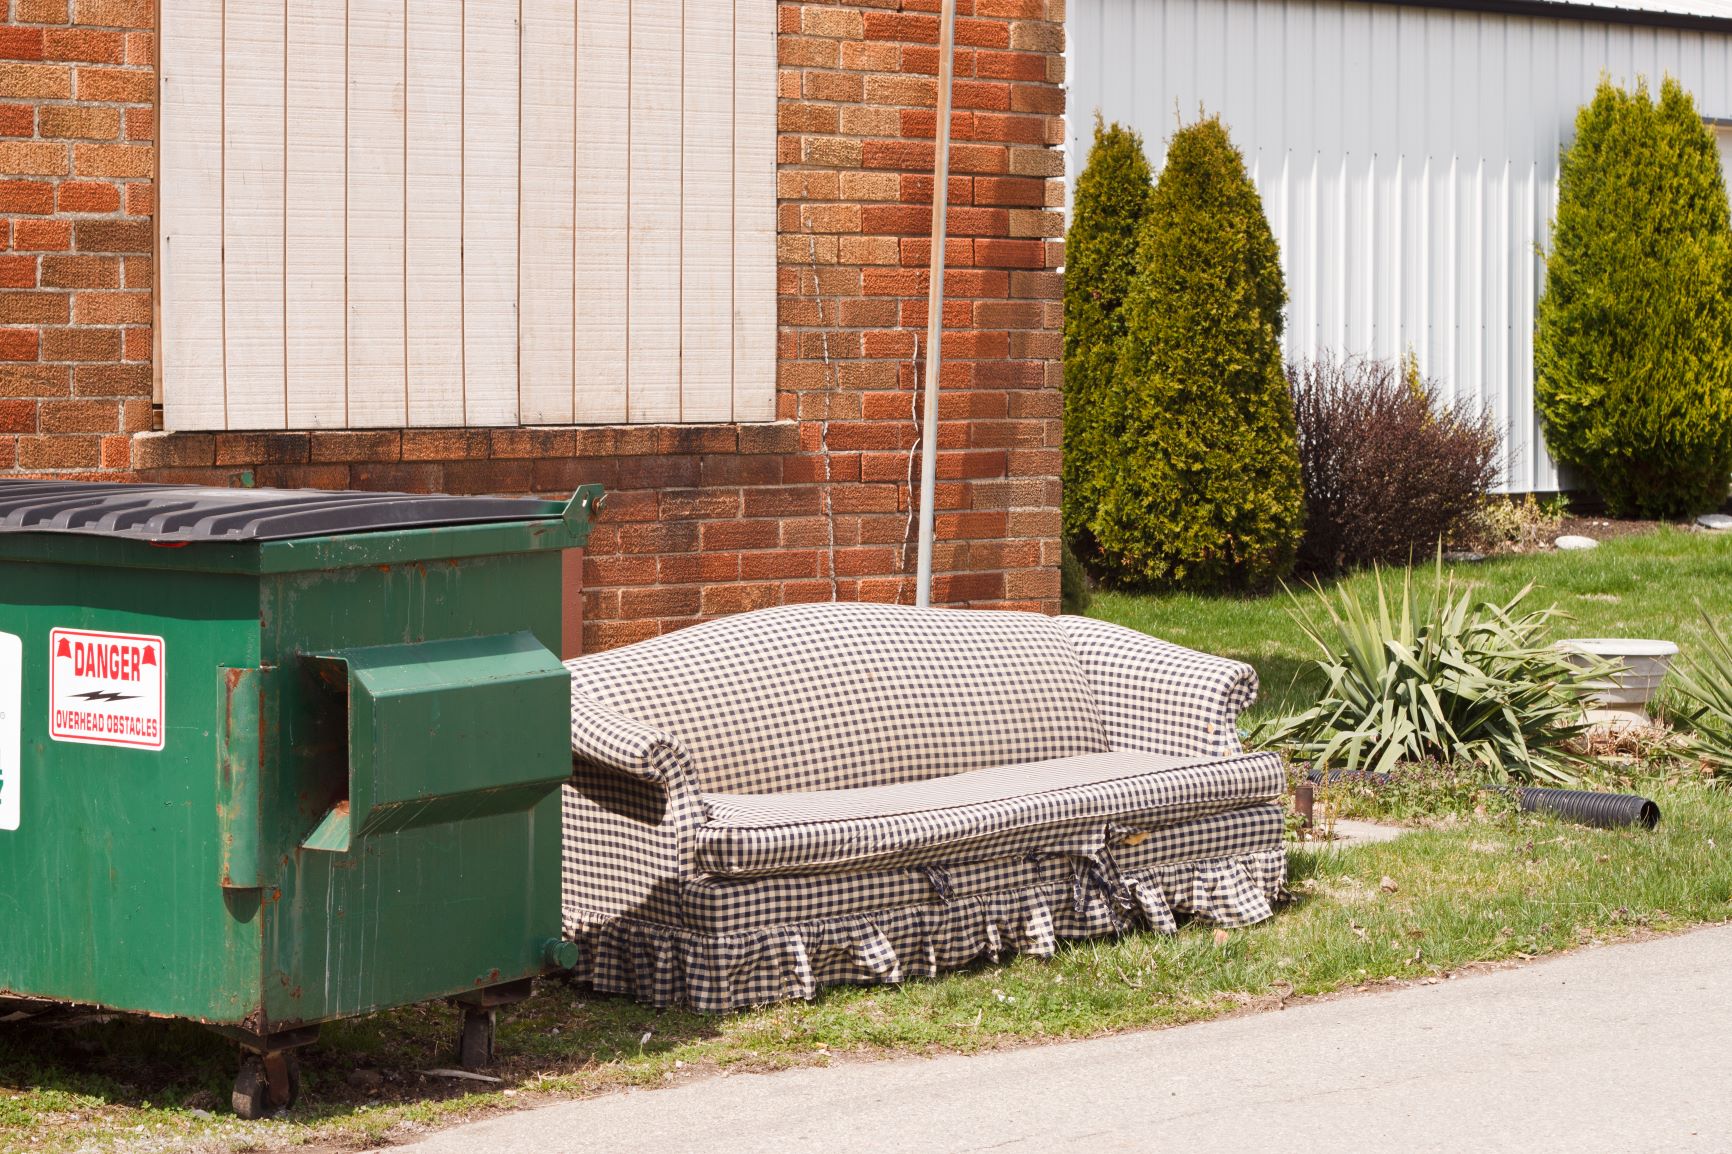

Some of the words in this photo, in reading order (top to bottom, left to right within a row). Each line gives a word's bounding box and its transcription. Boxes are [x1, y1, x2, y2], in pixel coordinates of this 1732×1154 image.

[74, 641, 141, 682] DANGER
[56, 709, 104, 733] OVERHEAD
[106, 714, 158, 738] OBSTACLES
